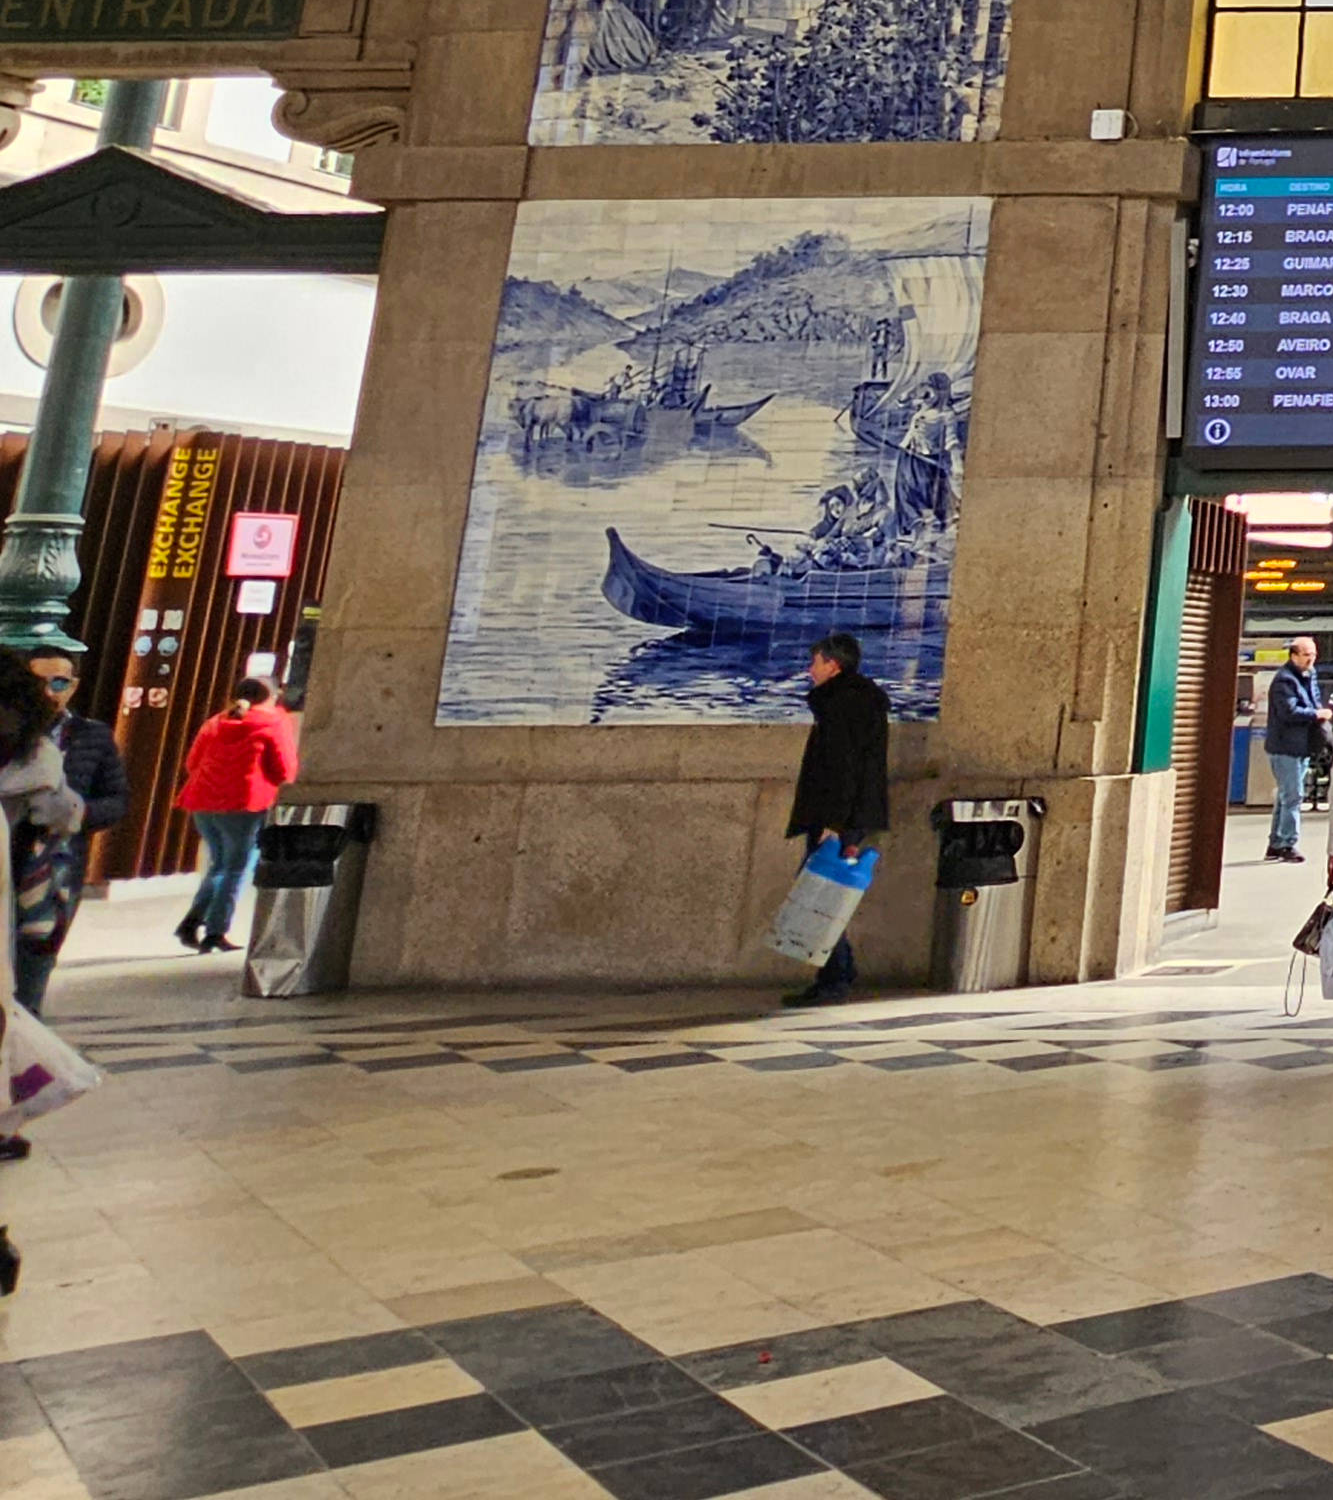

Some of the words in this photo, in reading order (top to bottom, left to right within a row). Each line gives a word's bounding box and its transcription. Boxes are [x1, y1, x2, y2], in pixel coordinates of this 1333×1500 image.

[1218, 204, 1254, 217] 12:00
[1216, 231, 1253, 244] 12:15
[1214, 257, 1250, 270] 12:25
[1212, 285, 1248, 297] 12:30
[1281, 284, 1333, 297] MARCO
[1210, 313, 1246, 325] 12:40
[1279, 311, 1331, 324] BRAGA
[1208, 340, 1244, 352] 12:50
[1276, 339, 1331, 352] AVEIRO
[1275, 367, 1317, 379] OVAR
[1203, 395, 1240, 407] 13:00
[148, 447, 192, 579] EXCHANGE
[173, 448, 218, 579] EXCHANGE
